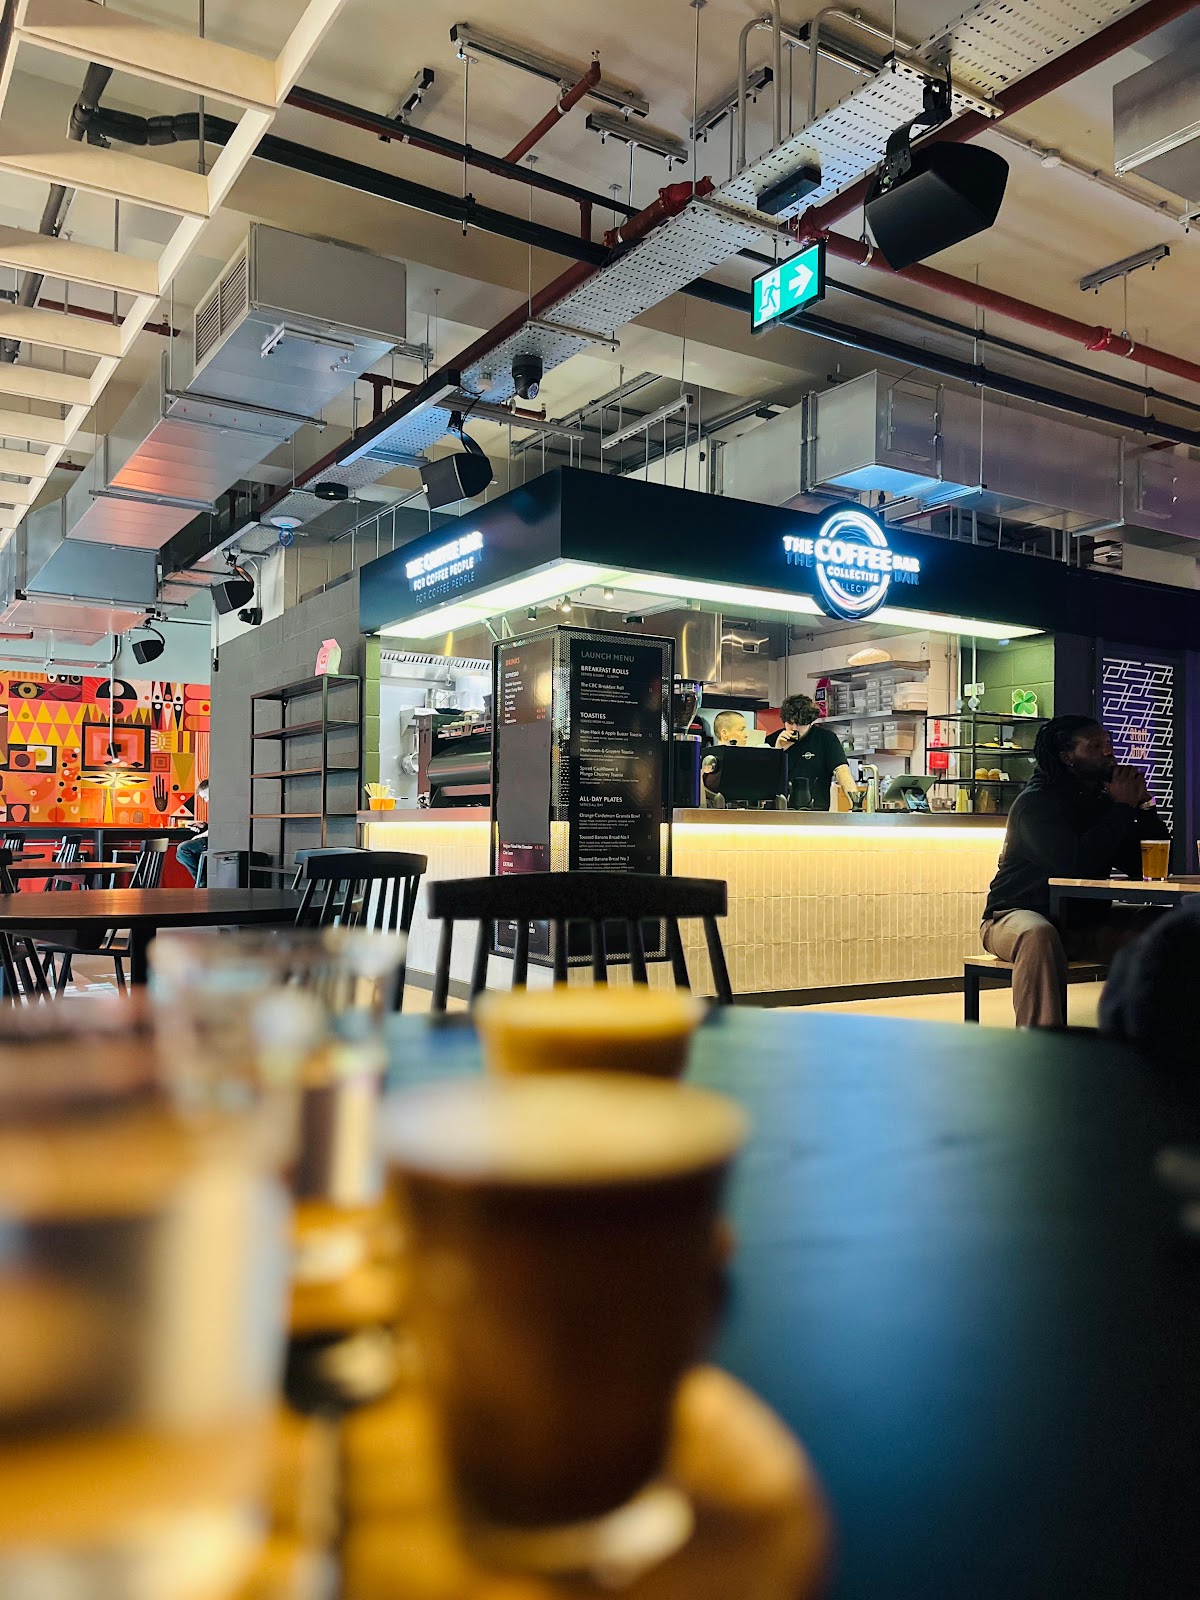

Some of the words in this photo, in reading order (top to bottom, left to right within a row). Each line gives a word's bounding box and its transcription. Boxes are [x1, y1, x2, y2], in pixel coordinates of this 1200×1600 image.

[782, 535, 814, 555] THE
[814, 538, 893, 572] COFFEE
[892, 555, 921, 573] BAR
[413, 577, 426, 592] FOR
[426, 566, 449, 587] COFFEE
[449, 556, 475, 576] PEOPLE
[826, 565, 880, 584] COLLECTIVE
[581, 651, 611, 660] LAUNCH
[613, 654, 635, 662] MENU
[581, 665, 611, 673] BREAKFAST
[1130, 727, 1148, 742] Staff
